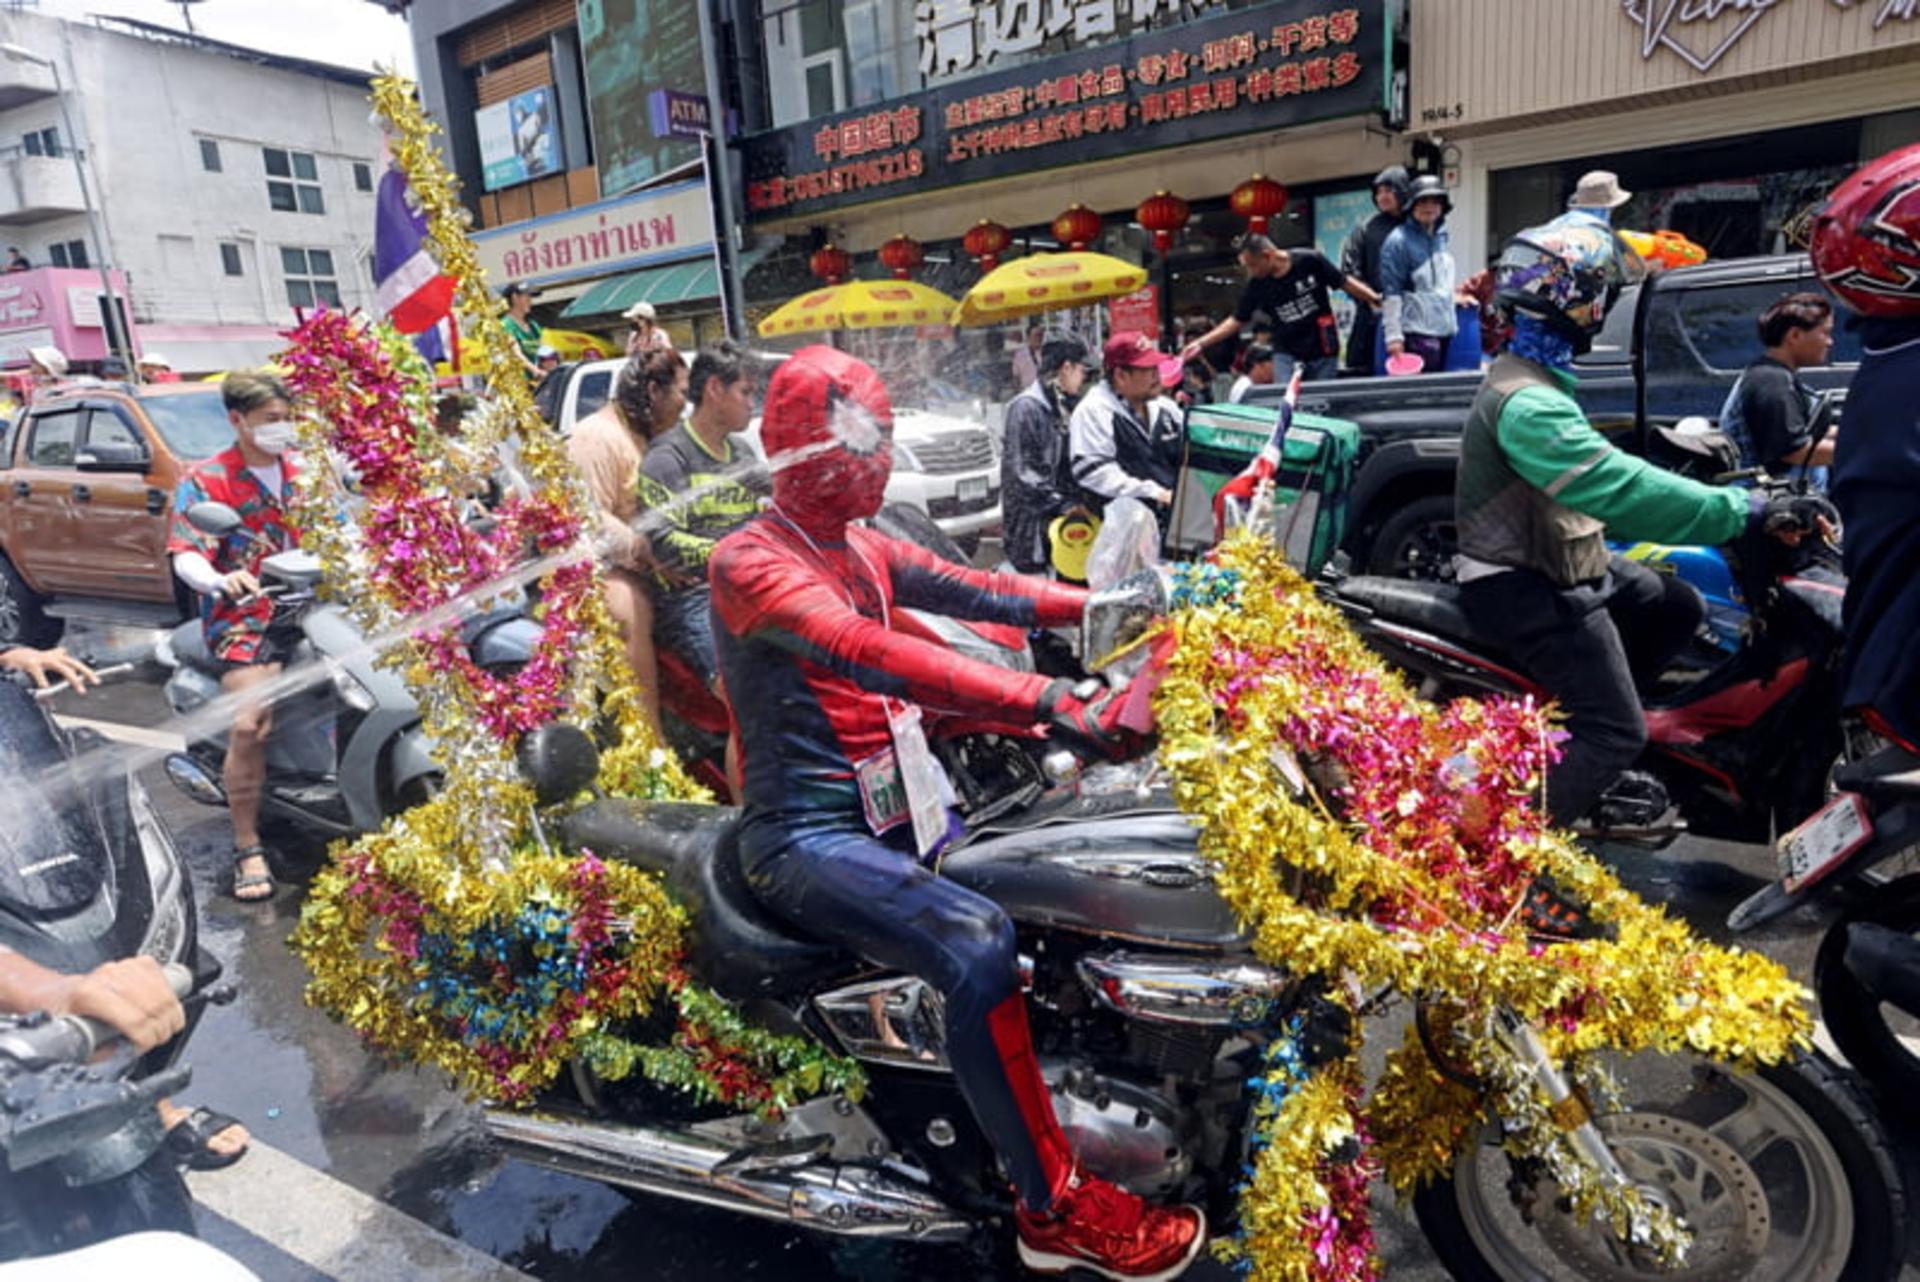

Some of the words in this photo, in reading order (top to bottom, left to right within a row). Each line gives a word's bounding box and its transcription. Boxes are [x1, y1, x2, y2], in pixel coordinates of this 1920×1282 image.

[671, 97, 708, 123] ATM
[814, 104, 921, 162] 中国超市
[502, 213, 677, 278] คลังยาท่าแพ
